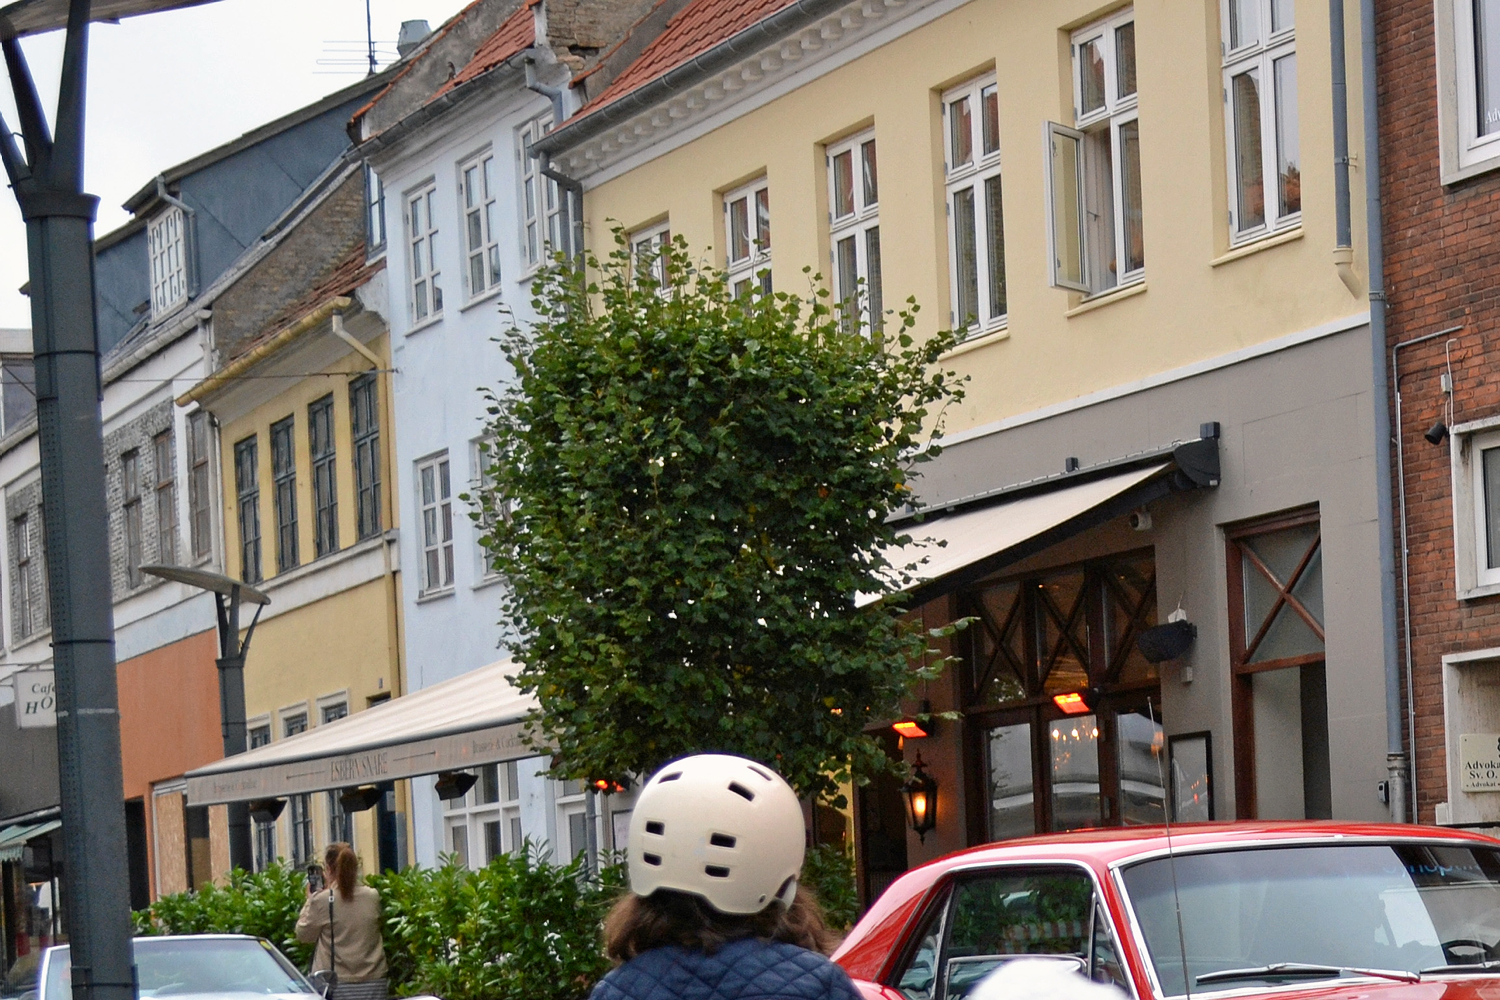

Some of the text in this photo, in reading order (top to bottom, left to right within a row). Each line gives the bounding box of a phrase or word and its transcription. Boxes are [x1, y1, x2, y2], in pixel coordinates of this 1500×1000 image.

[24, 696, 57, 715] HO
[1469, 770, 1484, 779] Sv.
[1486, 770, 1498, 779] O.
